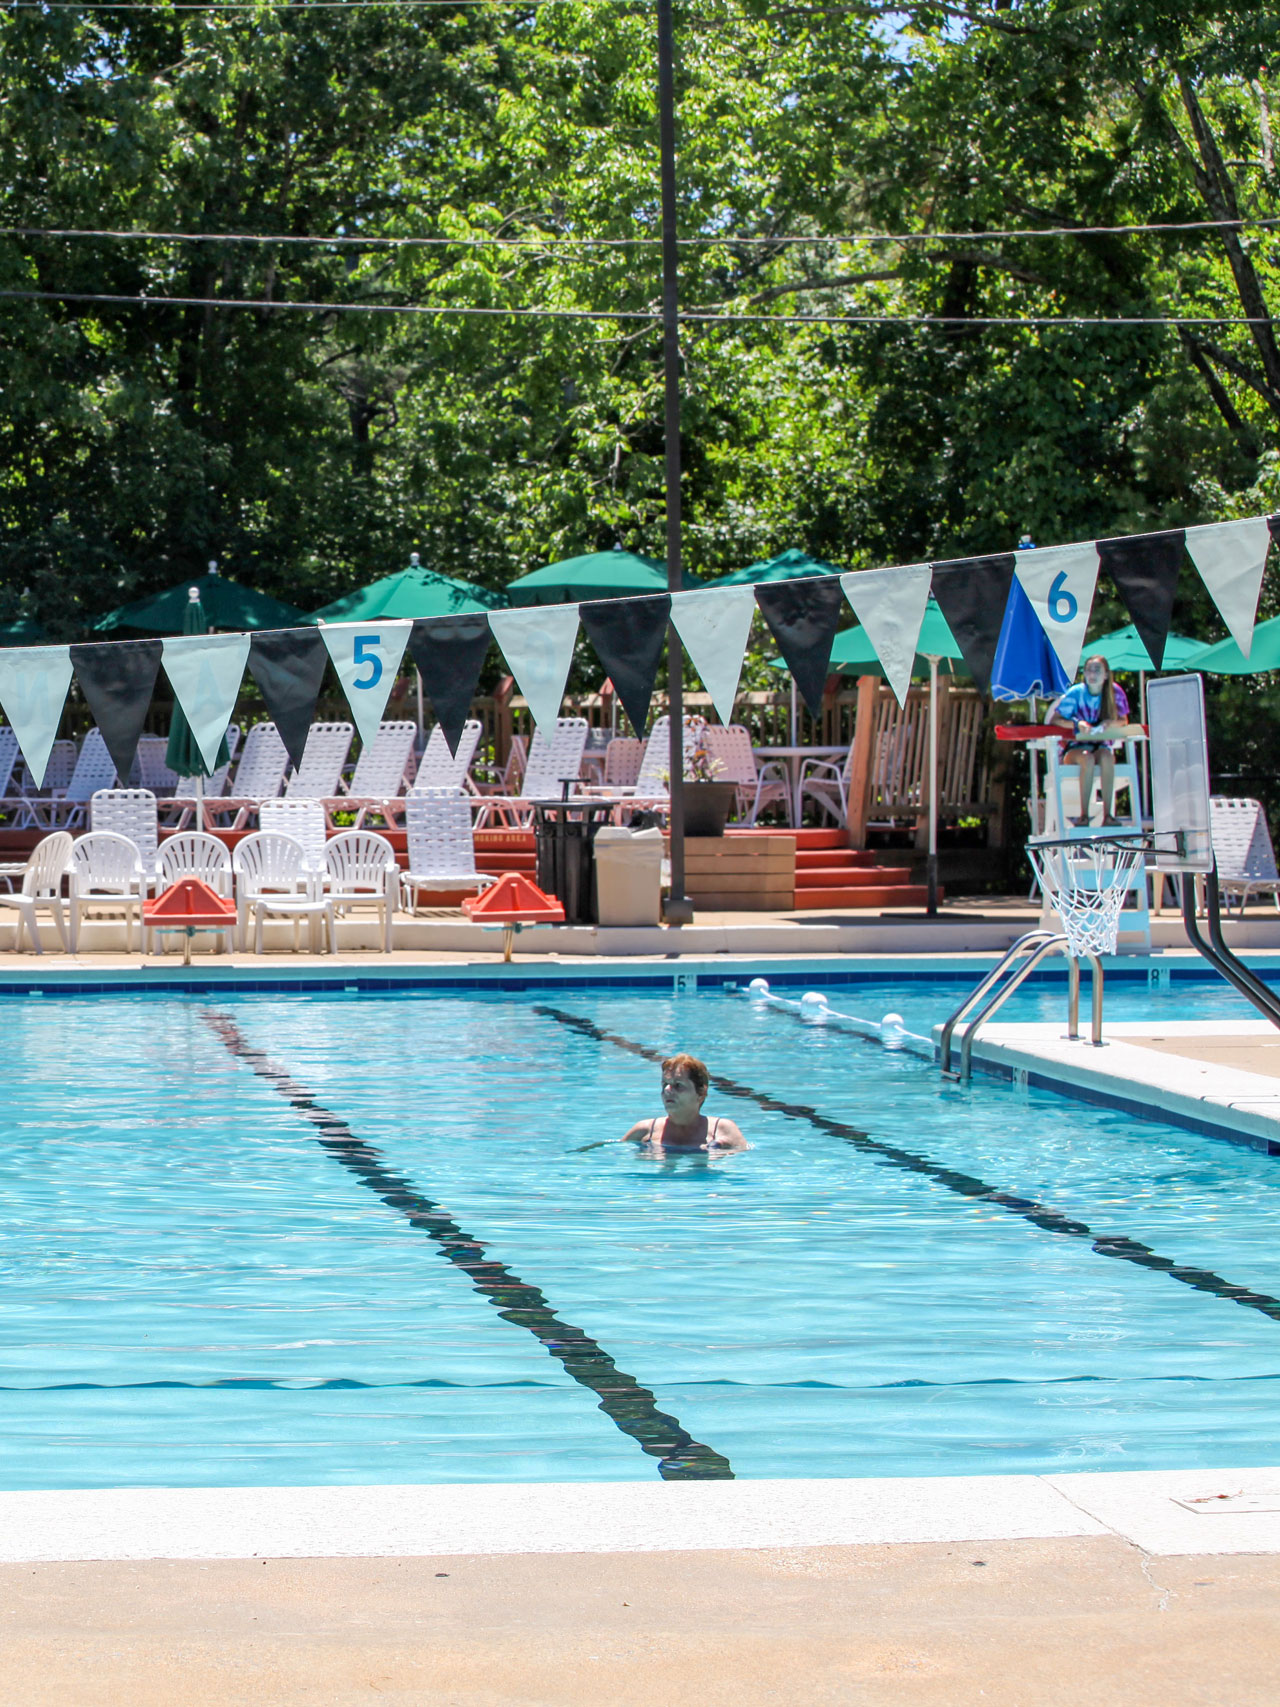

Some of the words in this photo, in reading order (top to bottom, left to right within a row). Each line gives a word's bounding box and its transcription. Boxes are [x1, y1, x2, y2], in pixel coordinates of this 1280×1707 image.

[1048, 570, 1078, 623] 6
[353, 635, 383, 690] 5
[474, 834, 503, 842] MOKING
